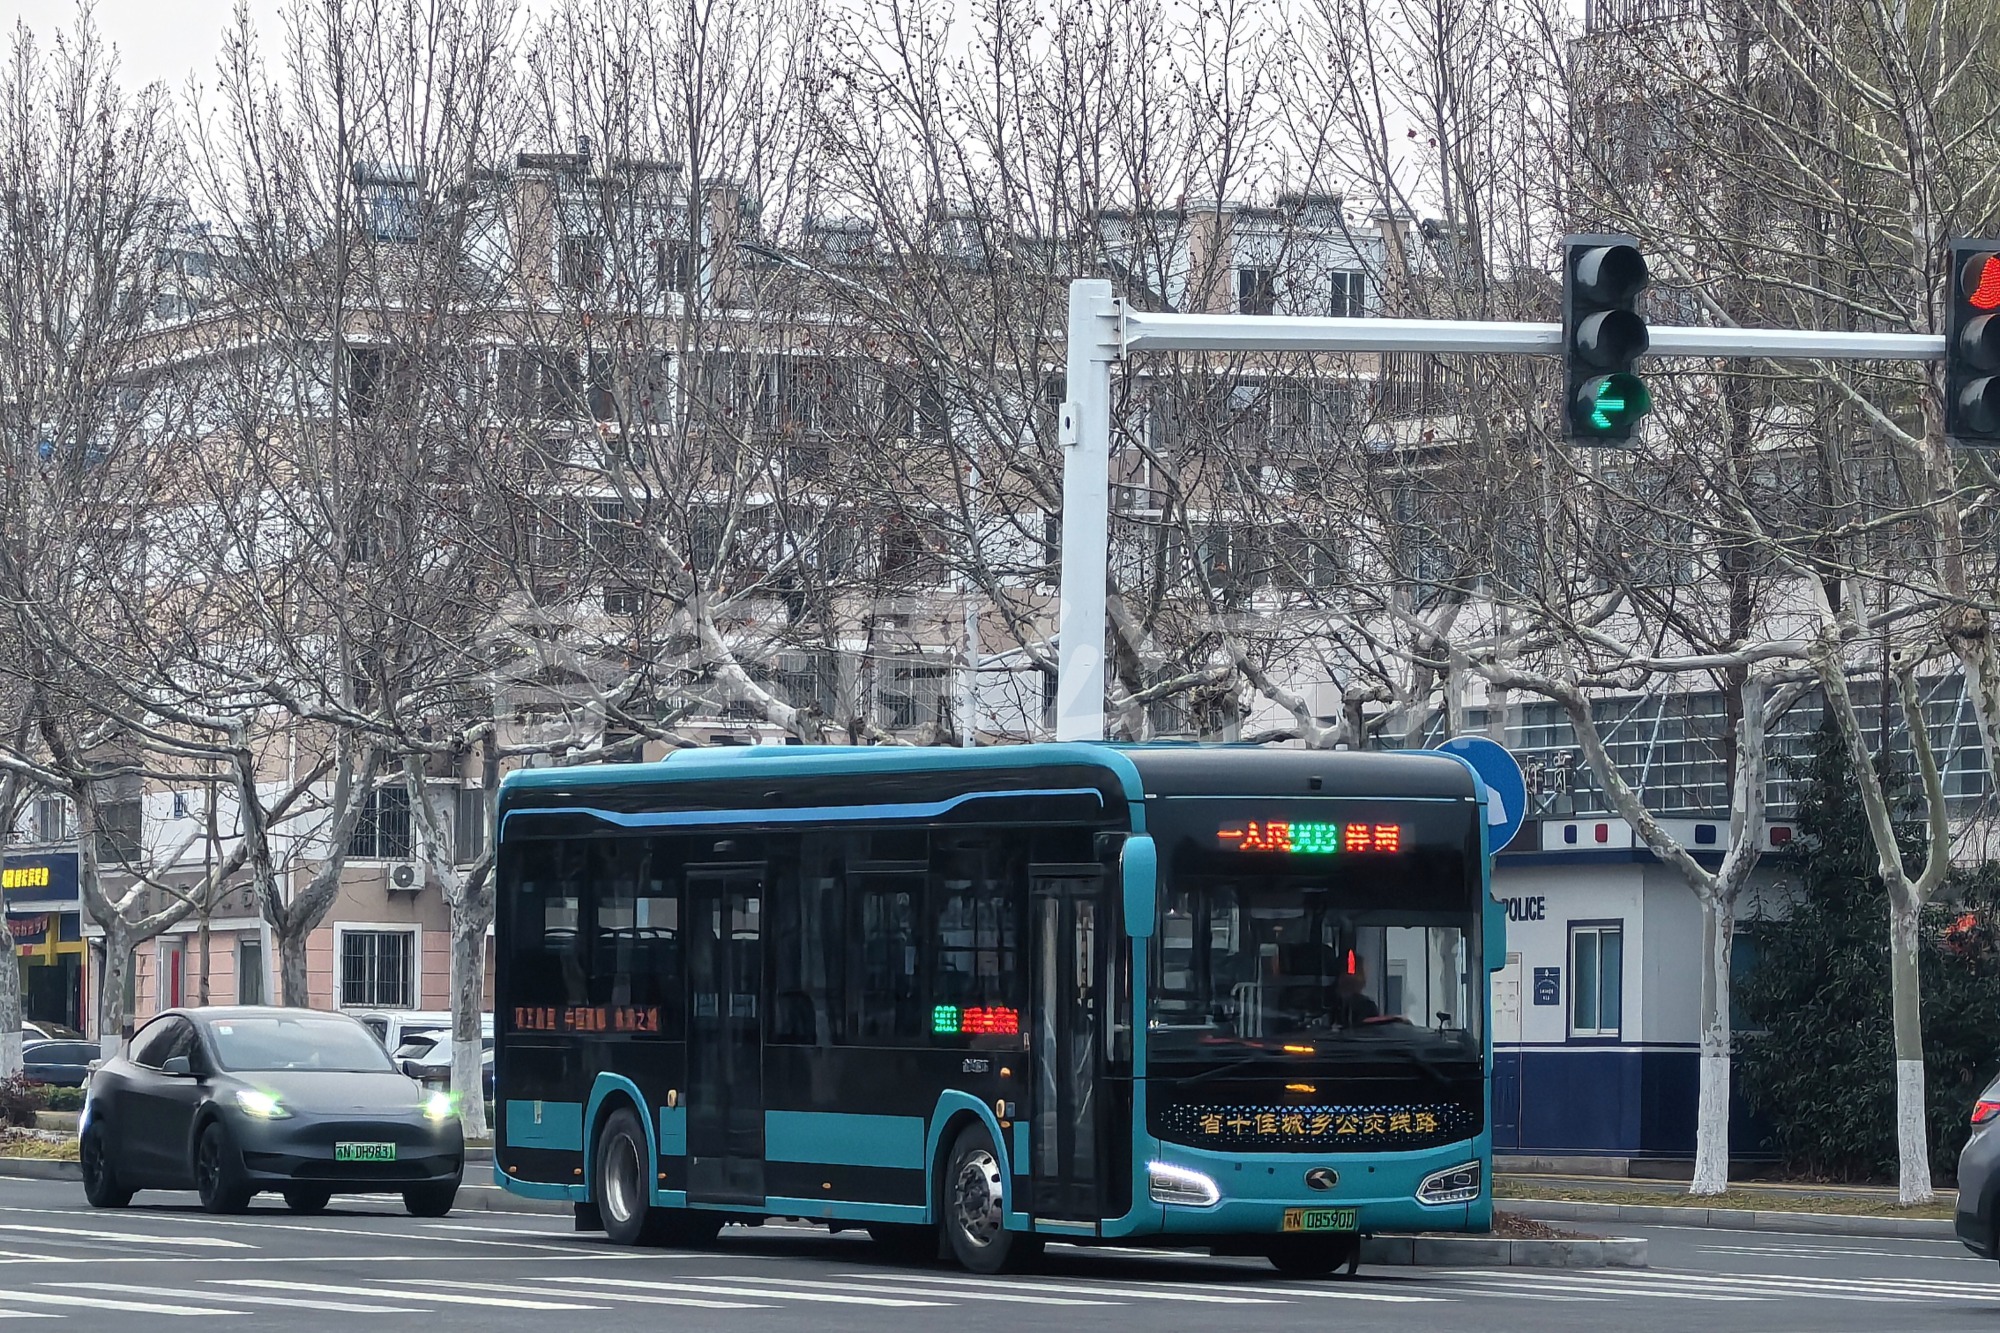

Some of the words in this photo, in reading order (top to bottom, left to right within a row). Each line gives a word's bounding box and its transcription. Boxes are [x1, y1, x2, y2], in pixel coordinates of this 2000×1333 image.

[1199, 1111, 1439, 1137] 省十佳城乡公交线路
